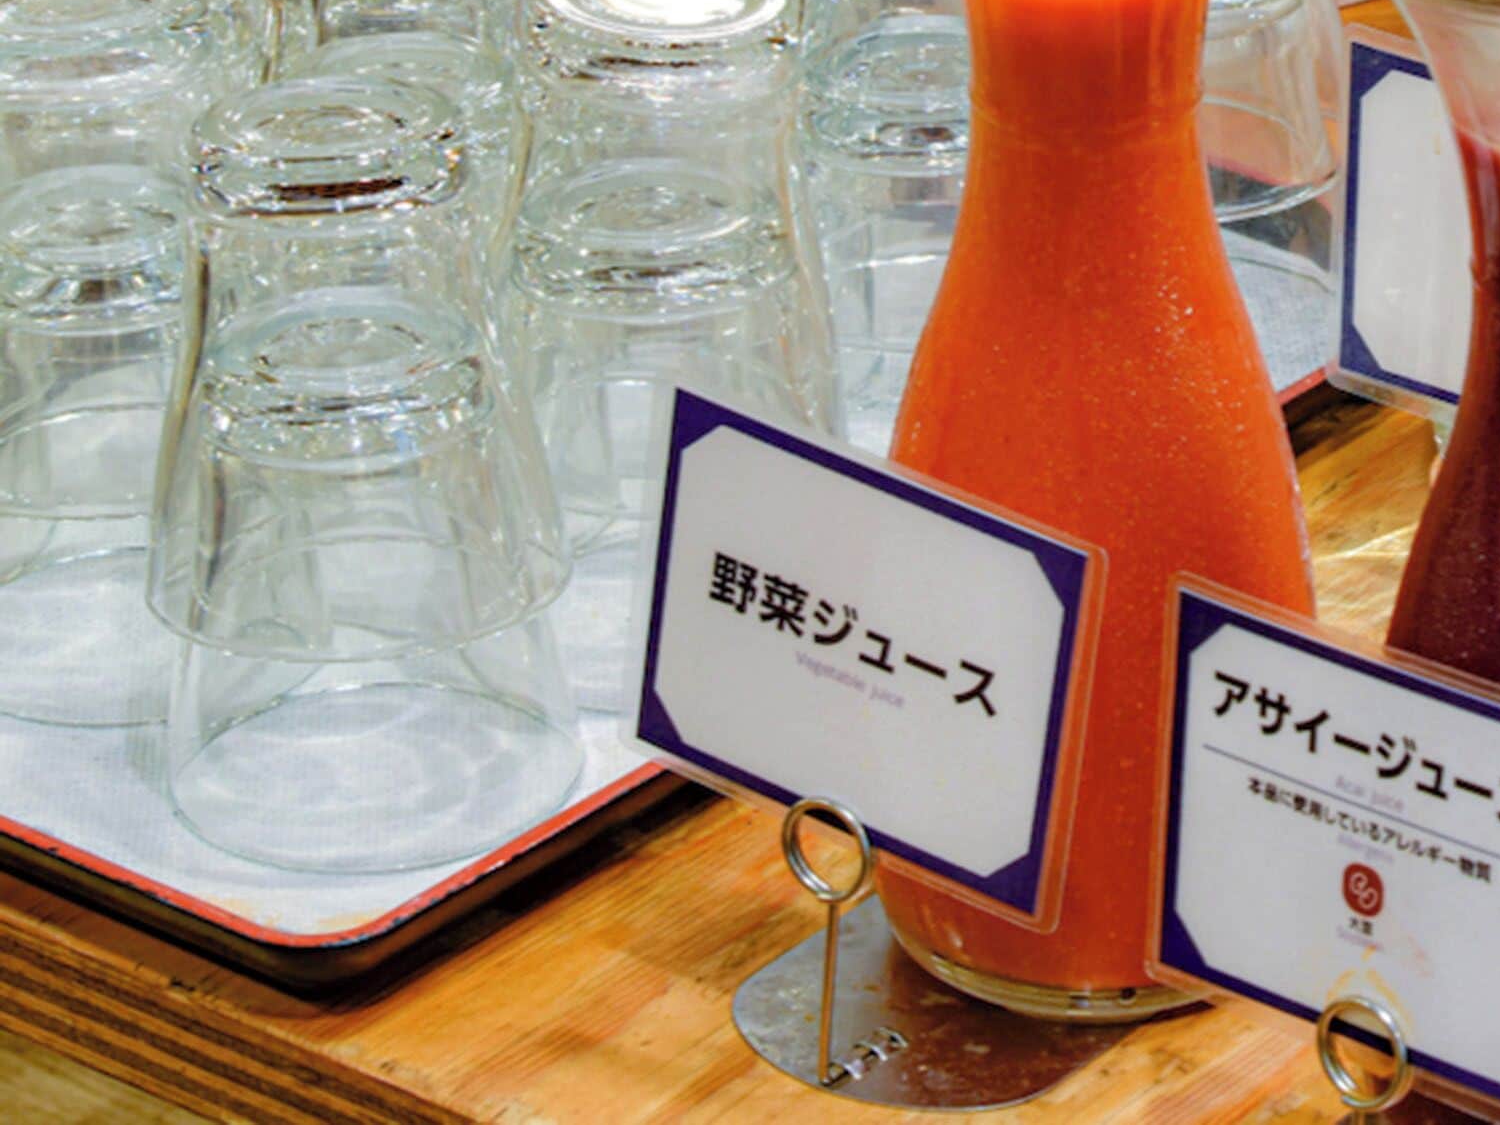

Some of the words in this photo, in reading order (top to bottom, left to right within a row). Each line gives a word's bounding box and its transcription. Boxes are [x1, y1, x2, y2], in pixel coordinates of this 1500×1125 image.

[709, 551, 997, 717] 野菜ジュース
